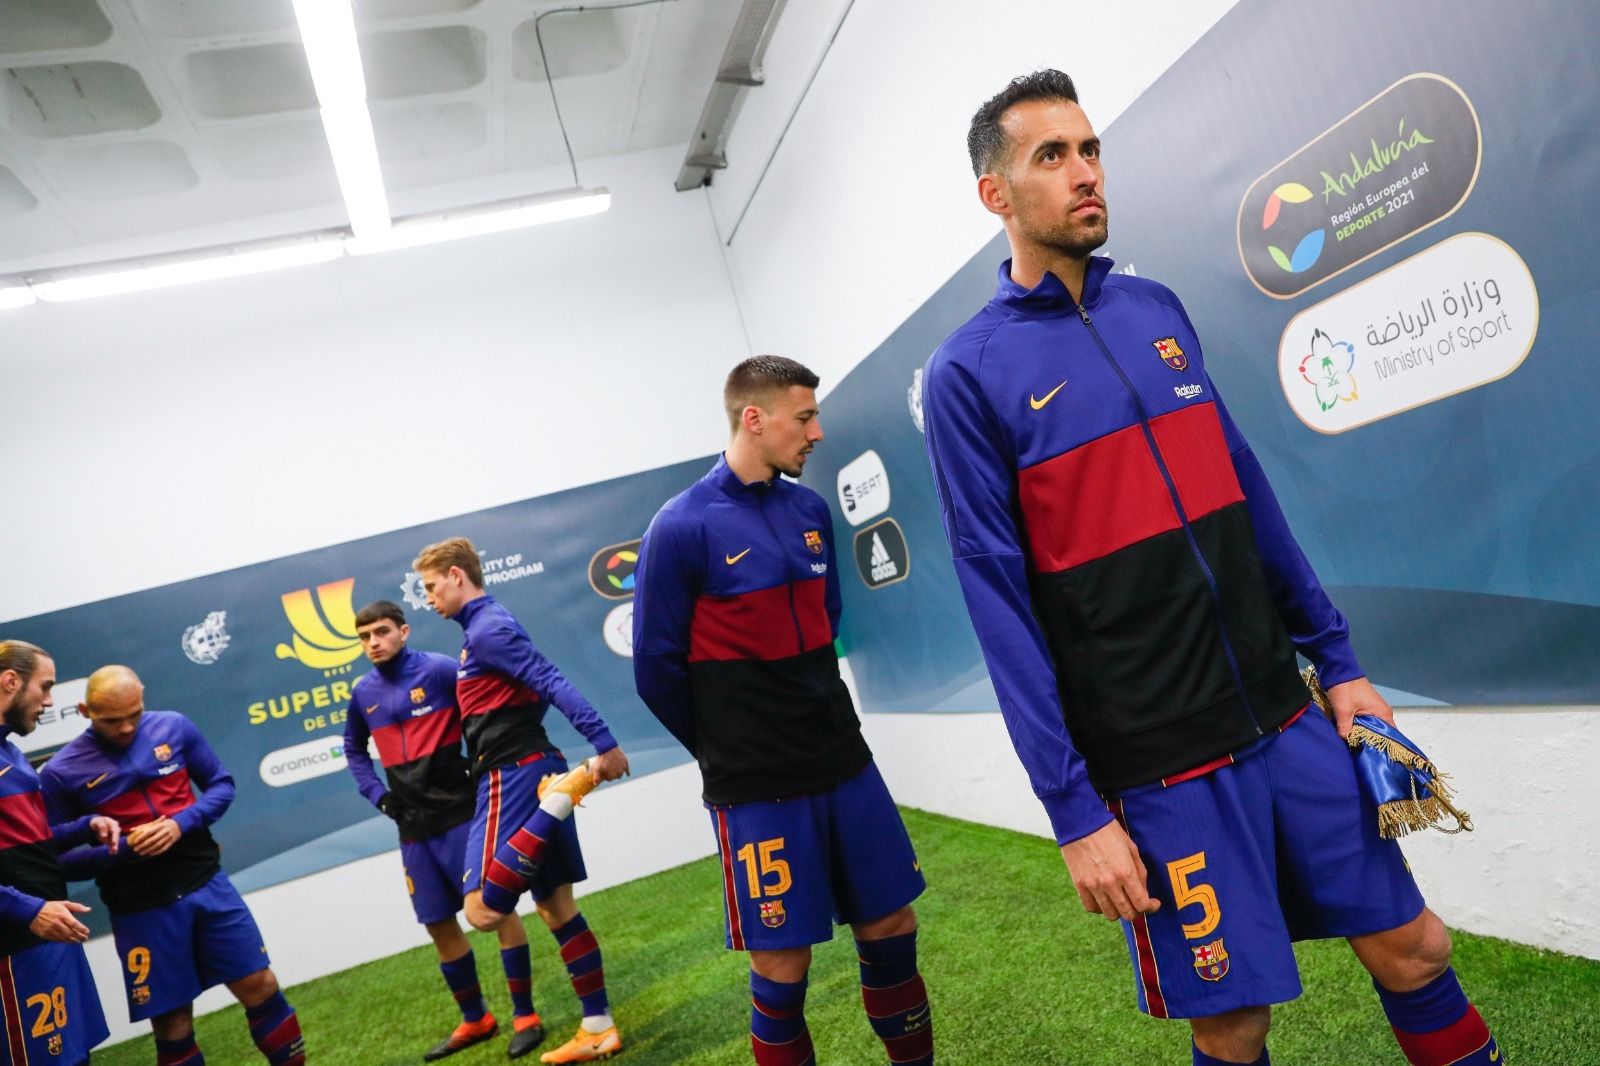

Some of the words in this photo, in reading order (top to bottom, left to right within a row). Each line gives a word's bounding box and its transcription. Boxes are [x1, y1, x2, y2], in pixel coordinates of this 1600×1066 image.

[1319, 117, 1435, 205] Andalucía
[1331, 203, 1365, 226] Región
[1365, 176, 1410, 206] Europea
[1411, 161, 1430, 180] del
[1336, 207, 1386, 241] DEPORTE
[1386, 189, 1415, 214] 2021
[1367, 298, 1437, 346] الرياضة
[1443, 279, 1501, 319] وزارة
[1374, 345, 1434, 380] Ministry
[1437, 331, 1455, 355] of
[1457, 310, 1512, 350] Sport
[1174, 383, 1203, 399] Rakuten
[484, 562, 544, 586] PROGRAM
[505, 553, 522, 567] OF
[247, 676, 361, 724] SUPER
[303, 715, 327, 731] DE
[270, 751, 329, 775] aramco
[737, 837, 792, 899] 15
[1166, 850, 1221, 940] 5
[127, 946, 151, 985] 9
[26, 986, 68, 1038] 28
